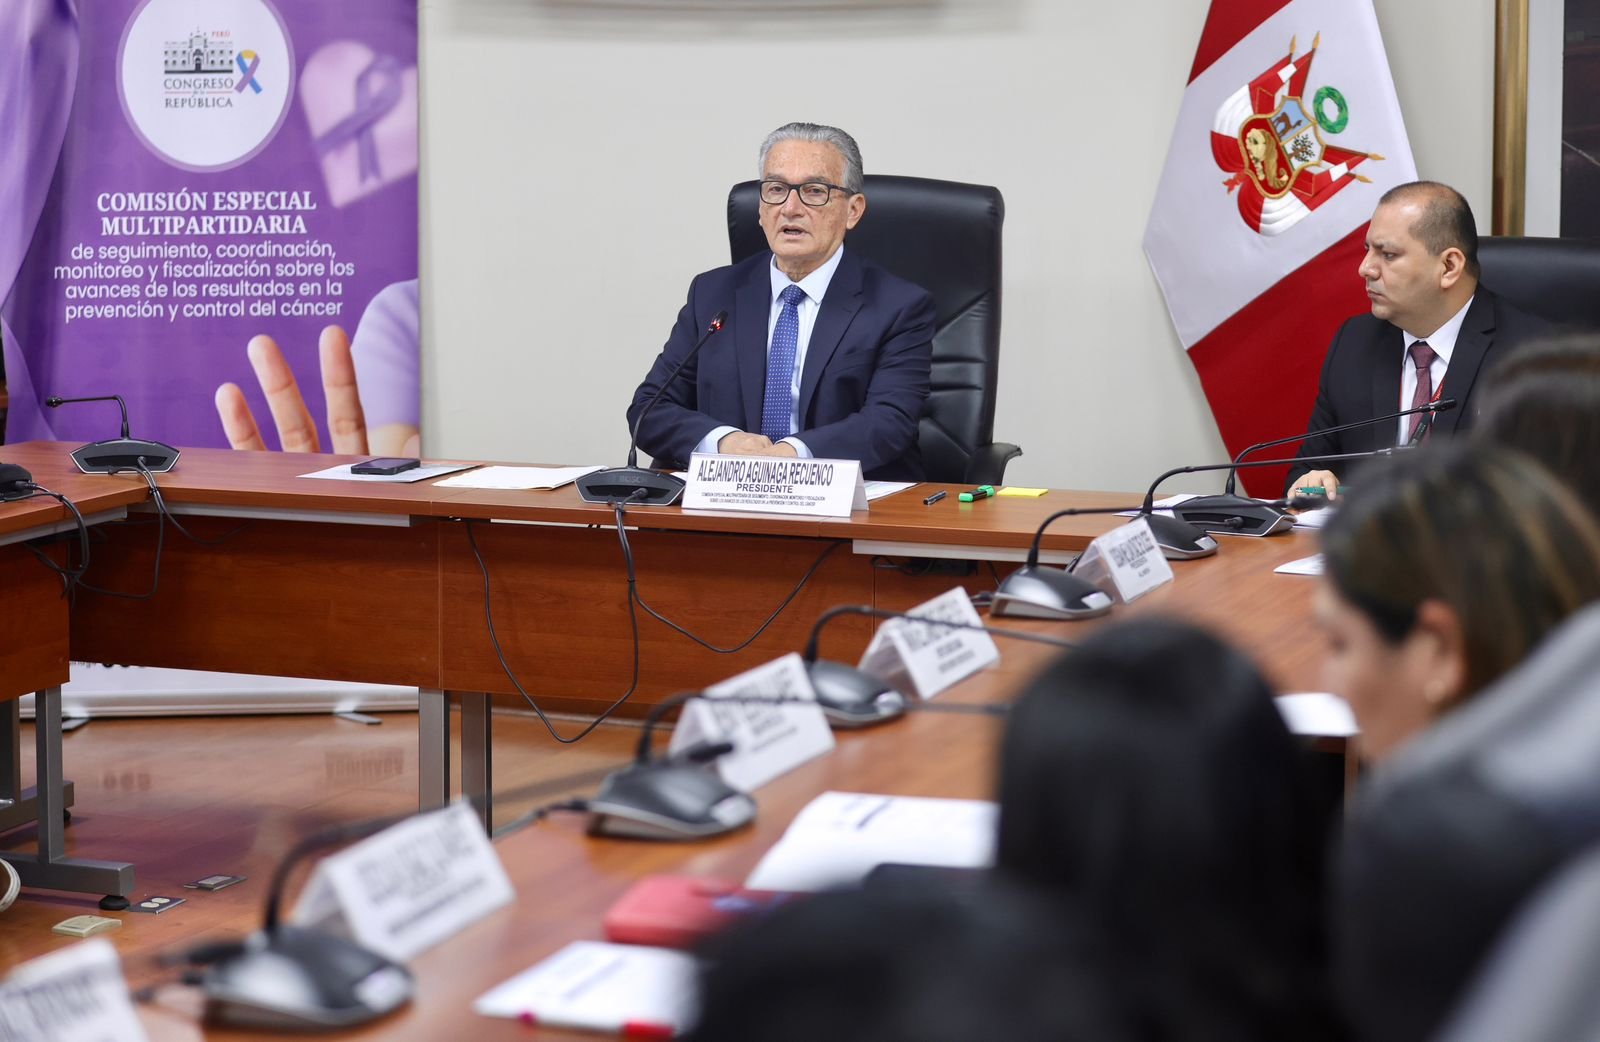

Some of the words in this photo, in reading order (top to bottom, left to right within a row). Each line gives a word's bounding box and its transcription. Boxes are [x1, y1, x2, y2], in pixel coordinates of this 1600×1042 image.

[164, 78, 234, 90] CONGRESO
[165, 96, 233, 108] REPÚBLICA
[97, 187, 208, 212] COMISIÓN
[212, 191, 317, 211] ESPECIAL
[101, 215, 308, 236] MULTIPARTIDARIA
[71, 243, 94, 260] de
[99, 243, 212, 263] seguimiento,
[216, 240, 336, 260] coordinación,
[54, 261, 144, 280] monitoreo
[148, 265, 159, 282] y
[163, 260, 271, 278] fiscalización
[275, 260, 325, 277] sobre
[329, 259, 355, 276] los
[65, 284, 141, 299] avances
[145, 280, 169, 298] de
[173, 281, 197, 297] los
[202, 280, 295, 298] resultados
[299, 282, 321, 296] en
[326, 279, 342, 296] la
[65, 301, 164, 324] prevención
[168, 304, 178, 322] y
[183, 300, 245, 318] control
[249, 300, 276, 317] del
[280, 299, 343, 316] cáncer
[697, 460, 745, 482] ALEJANDRO
[746, 461, 789, 484] AGUINAGA
[789, 464, 834, 487] RECUENCO
[736, 484, 793, 494] PRESIDENTE
